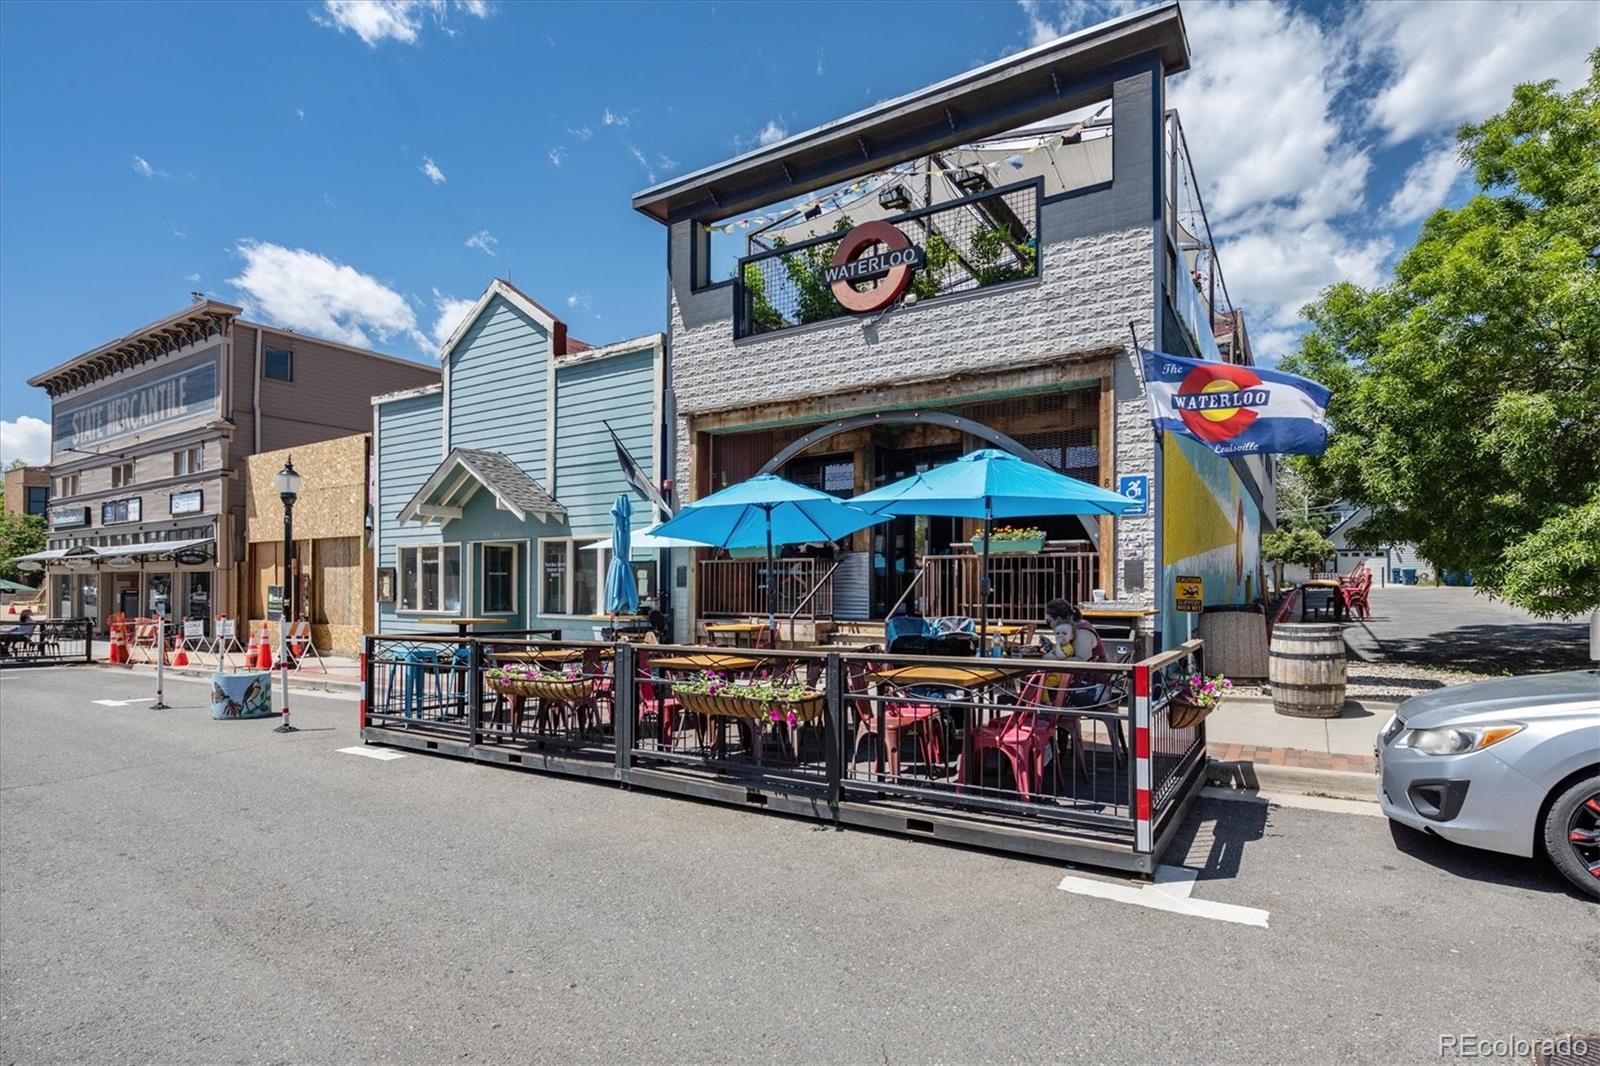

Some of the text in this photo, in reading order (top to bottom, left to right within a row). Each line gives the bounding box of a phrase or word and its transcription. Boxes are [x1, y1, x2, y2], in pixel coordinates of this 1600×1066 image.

[825, 248, 916, 282] WATERLOO
[1162, 364, 1184, 375] The
[1174, 391, 1266, 410] WATERLOO
[72, 376, 188, 445] STATE MERCANTILE
[1214, 441, 1259, 454] Louisville
